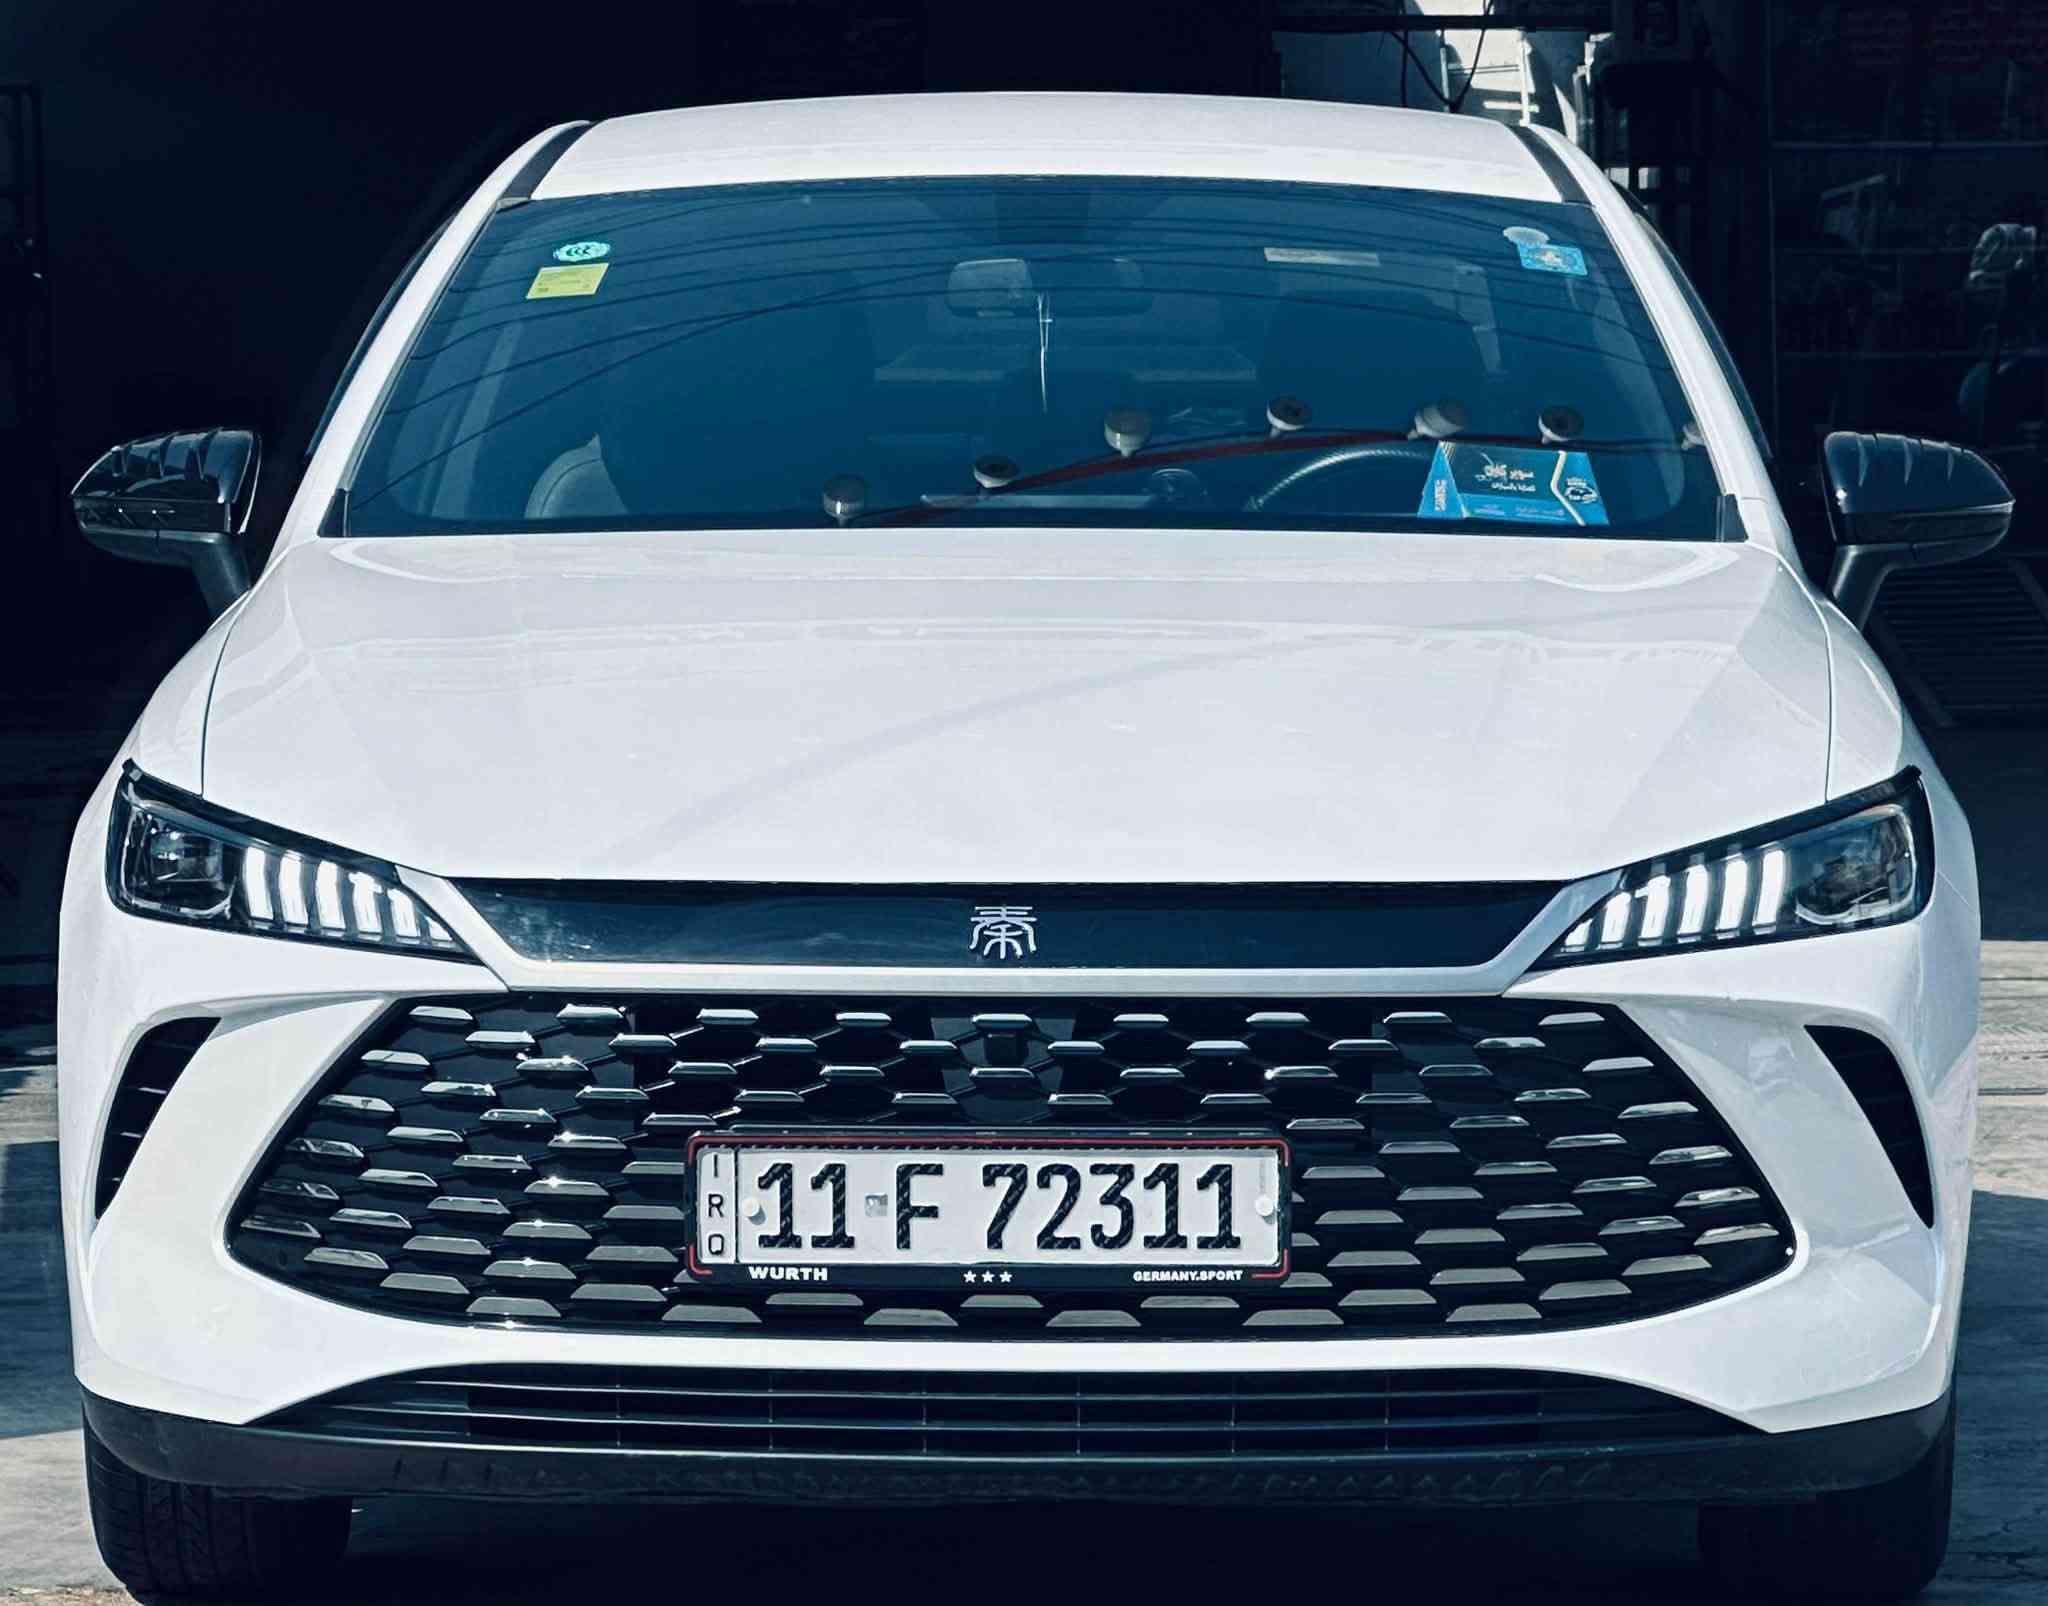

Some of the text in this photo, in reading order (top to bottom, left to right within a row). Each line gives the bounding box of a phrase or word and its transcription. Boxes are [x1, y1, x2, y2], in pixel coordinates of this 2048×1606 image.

[758, 1162, 1243, 1250] 11 F 72311
[748, 1266, 829, 1282] WURTH
